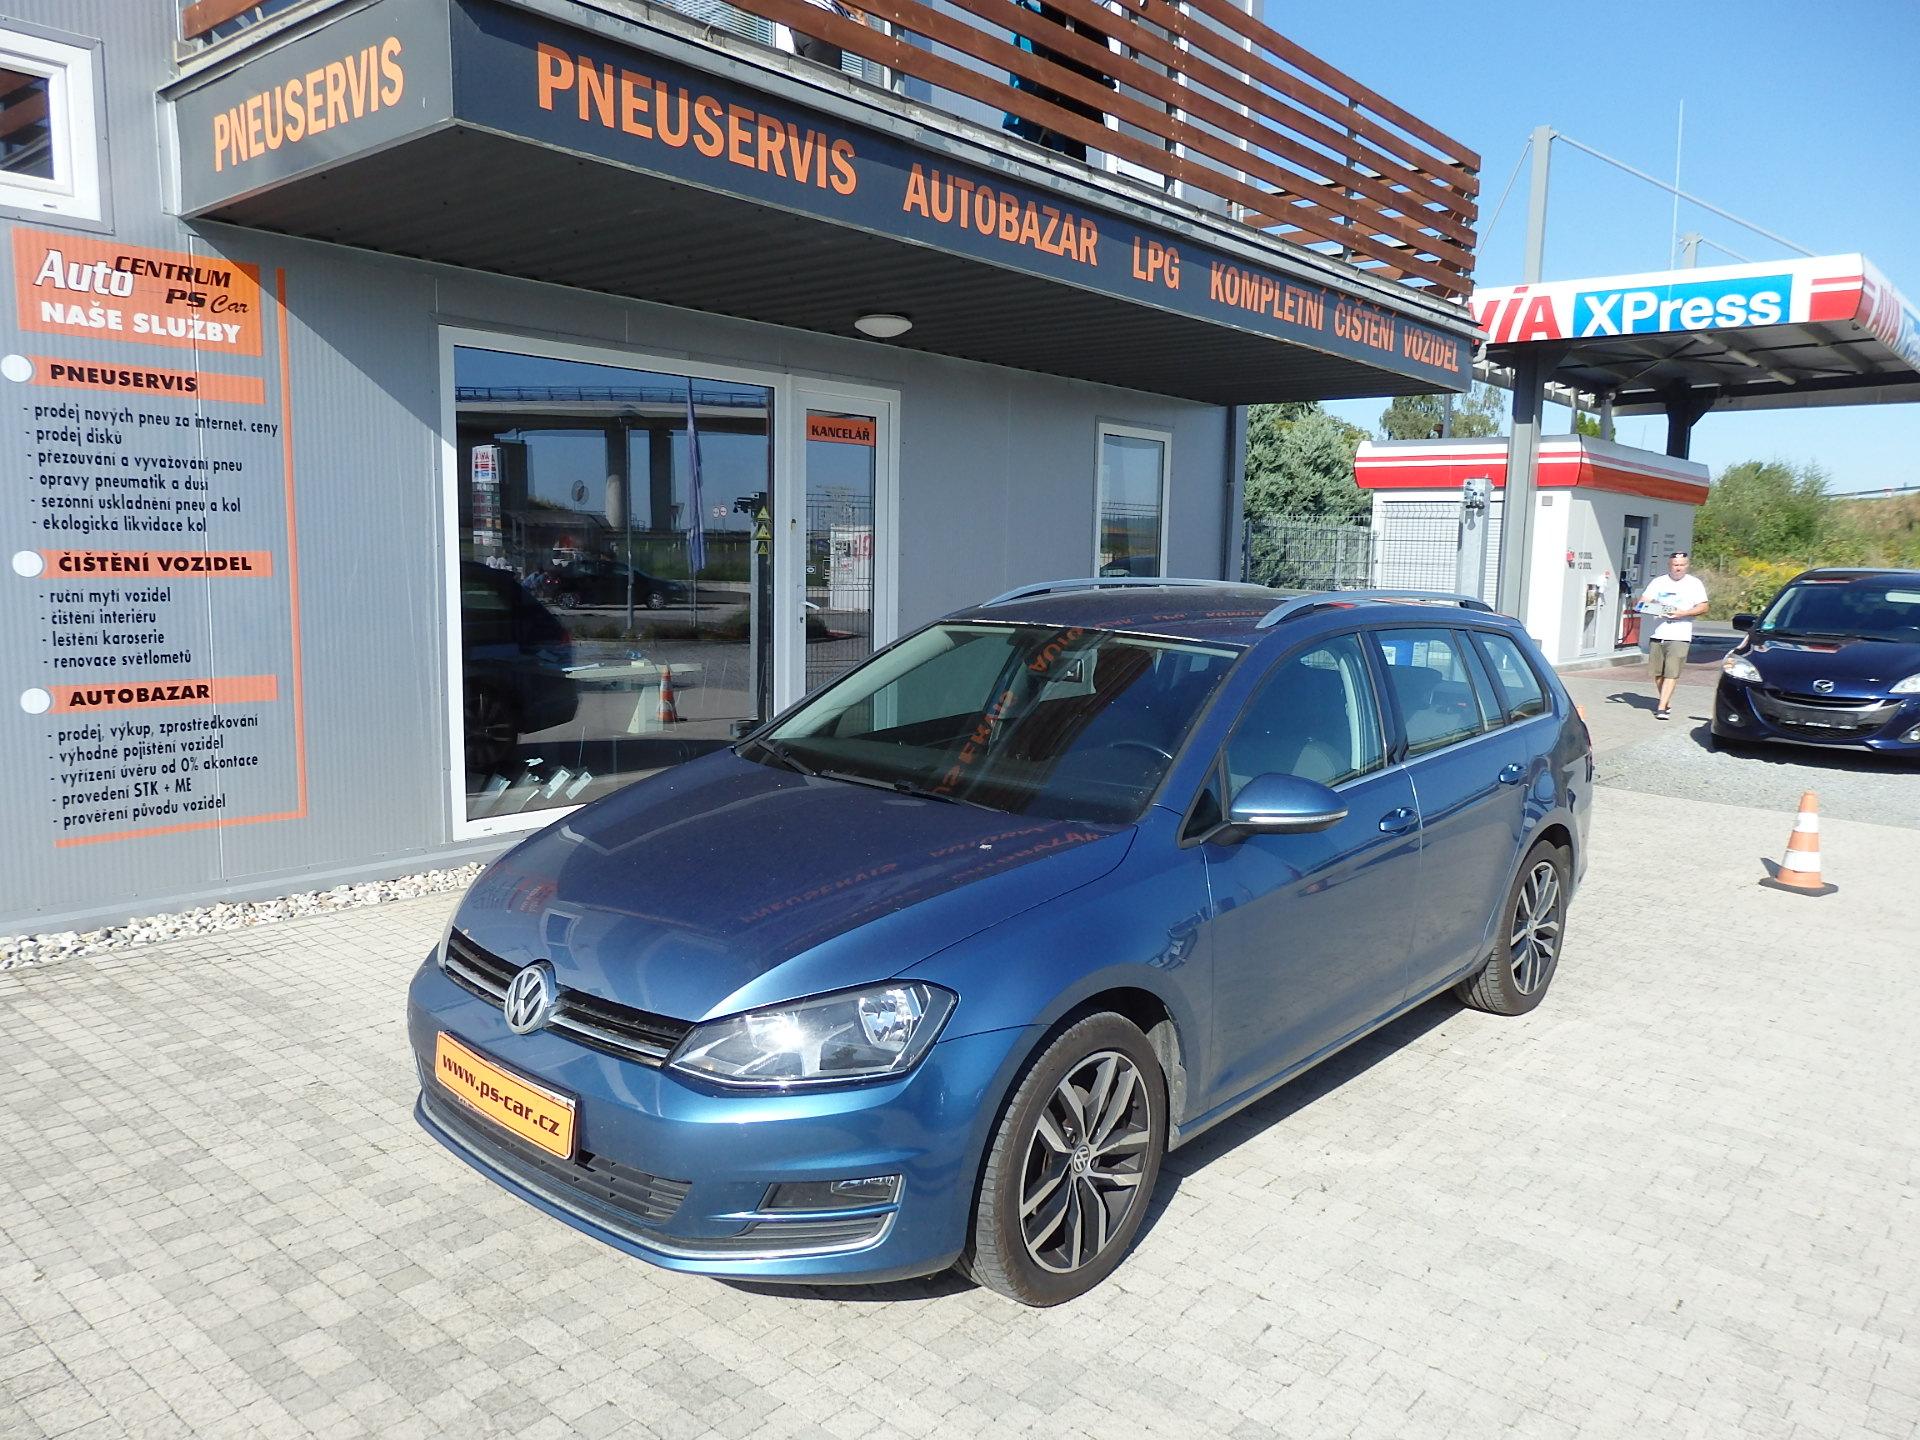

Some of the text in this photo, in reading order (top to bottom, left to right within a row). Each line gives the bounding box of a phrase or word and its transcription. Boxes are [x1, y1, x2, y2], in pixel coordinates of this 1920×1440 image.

[214, 36, 404, 172] PNEUSERVIS
[538, 42, 1459, 372] PNEUSERVIS AUTOBAZAR LPG KOMPLETNÍ ČIŠTĚNÍ VOZIDEL
[33, 248, 231, 297] Auto CENTRUM
[166, 288, 249, 314] PS Car
[41, 300, 241, 344] NAŠE SLUŽBY
[1582, 291, 1781, 336] XPress
[50, 363, 198, 392] PNEUSERVIS
[35, 403, 80, 423] prodej
[139, 413, 170, 427] pneu
[175, 416, 189, 427] za
[195, 413, 246, 431] internet.
[251, 422, 278, 437] ceny
[36, 426, 81, 446] prodej
[811, 424, 870, 441] KANCELÁŘ
[121, 456, 128, 466] a
[213, 460, 243, 474] pneu
[40, 474, 89, 491] opravy
[95, 474, 166, 491] pneumatik
[171, 479, 179, 490] a
[175, 500, 205, 514] pneu
[210, 501, 218, 512] a
[222, 497, 241, 512] kol
[123, 515, 183, 532] likvidace
[187, 516, 207, 532] kol
[58, 552, 252, 572] ČIŠTĚNÍ VOZIDEL
[125, 587, 171, 602] vozidel
[102, 629, 165, 645] karoserie
[54, 655, 117, 669] renovace
[69, 684, 210, 706] AUTOBAZAR
[181, 734, 224, 752] vozidel
[161, 759, 176, 774] od
[181, 757, 199, 772] 0%
[203, 755, 258, 770] akontace
[134, 780, 159, 798] STK
[175, 777, 192, 793] ME
[182, 793, 226, 811] vozidel
[443, 1054, 560, 1137] www.ps-car.cz
